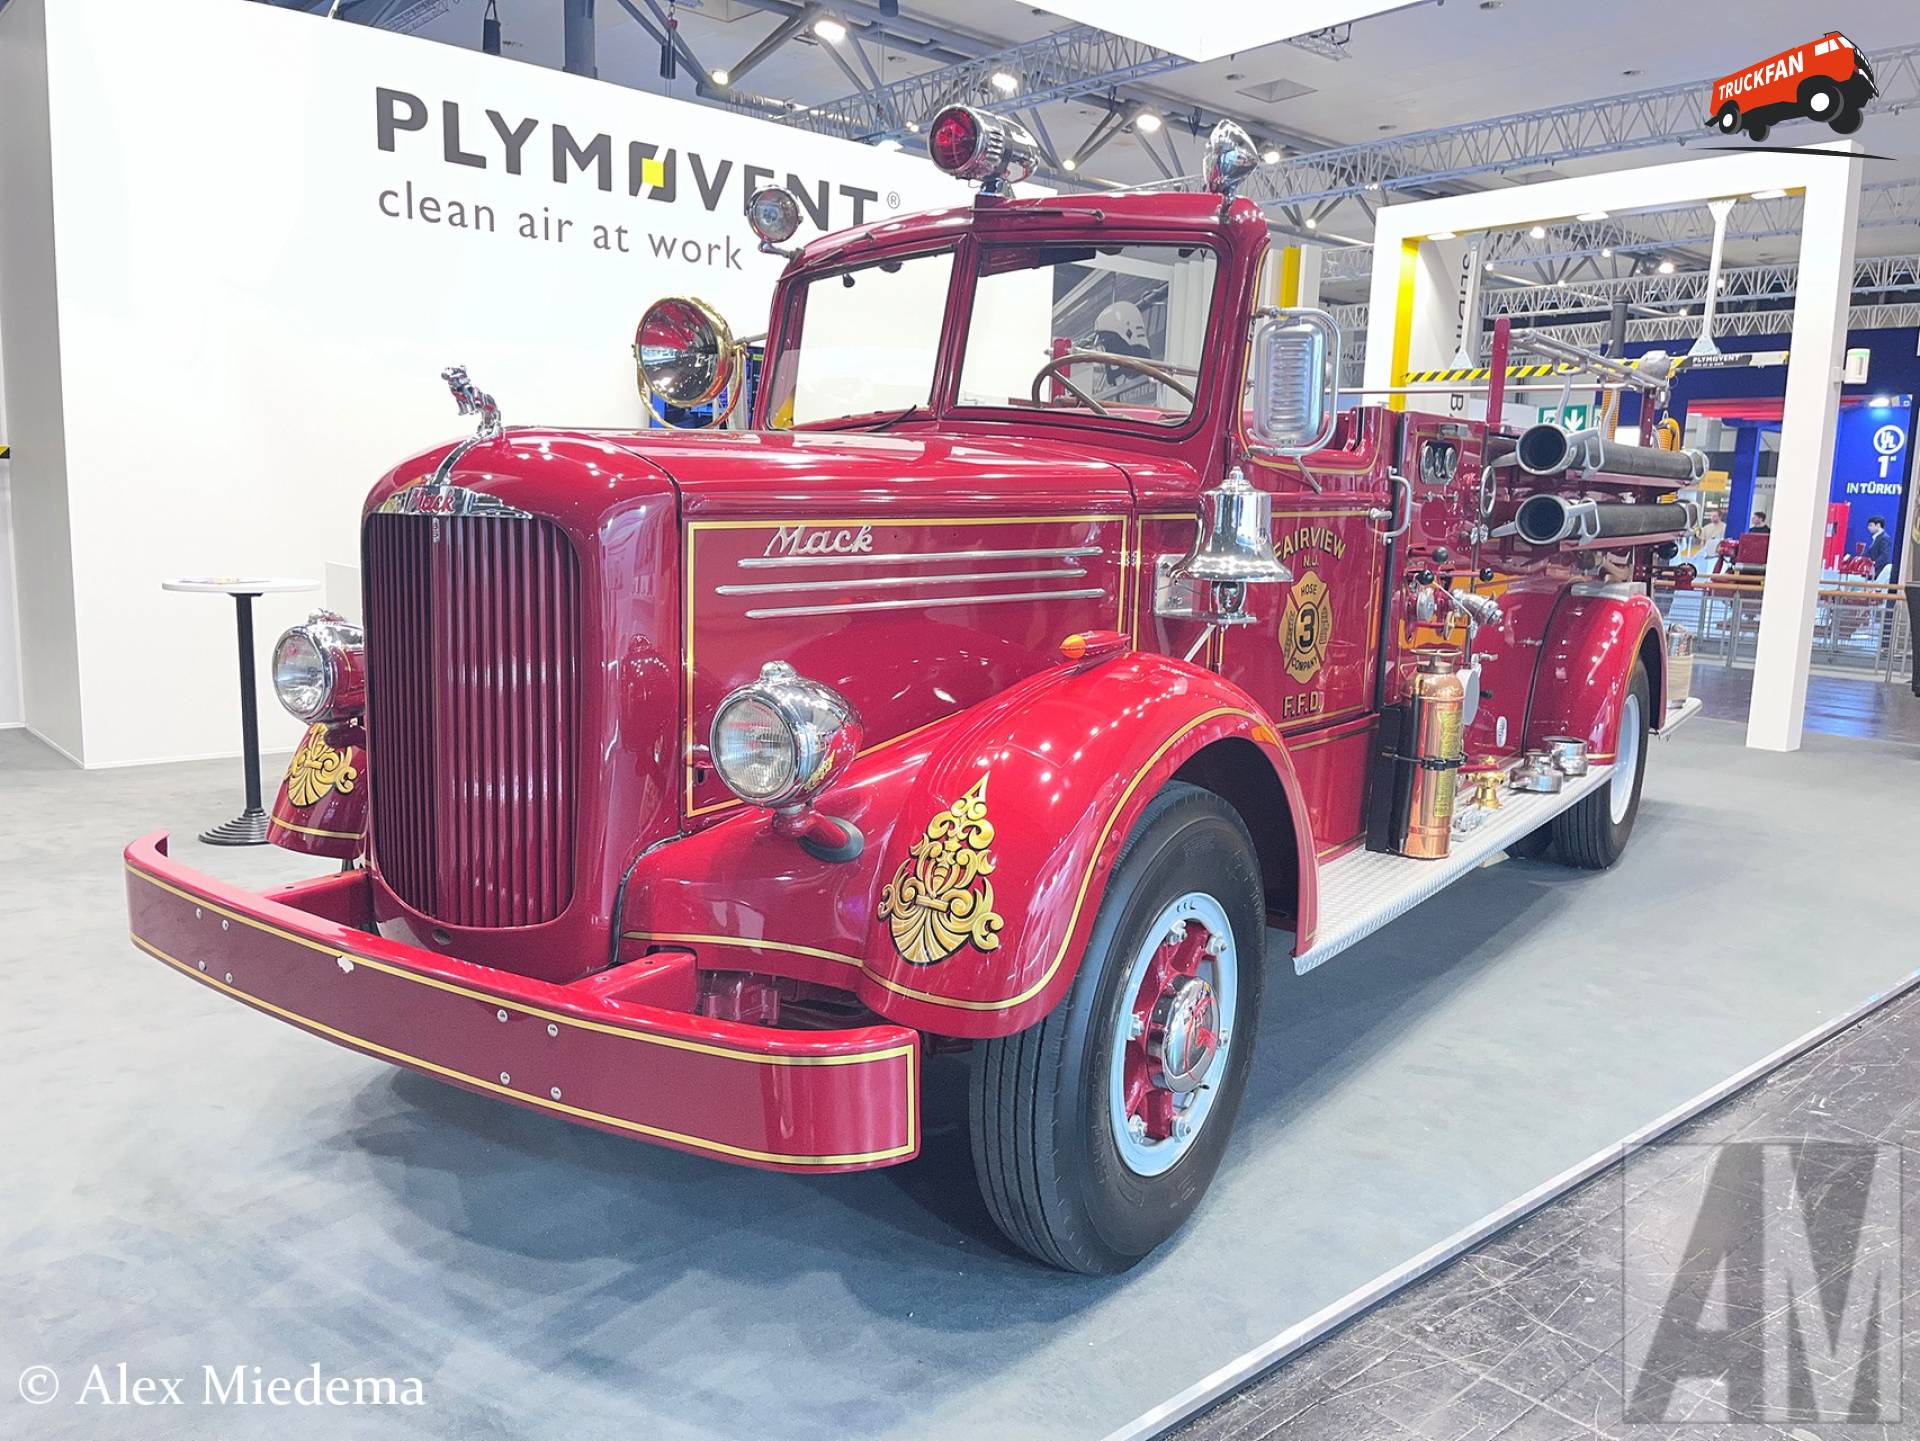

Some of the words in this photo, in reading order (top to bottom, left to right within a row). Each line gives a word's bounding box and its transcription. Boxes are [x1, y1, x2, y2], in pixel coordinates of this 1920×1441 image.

[378, 181, 496, 233] clean
[518, 206, 573, 244] air
[592, 223, 630, 253] at
[648, 231, 743, 270] work
[1846, 482, 1859, 494] IN
[763, 524, 873, 557] Mack
[1273, 526, 1346, 561] FAIRVIEW
[1300, 583, 1318, 597] HOSE
[1300, 608, 1315, 648] 3
[1291, 657, 1318, 671] COMPANY
